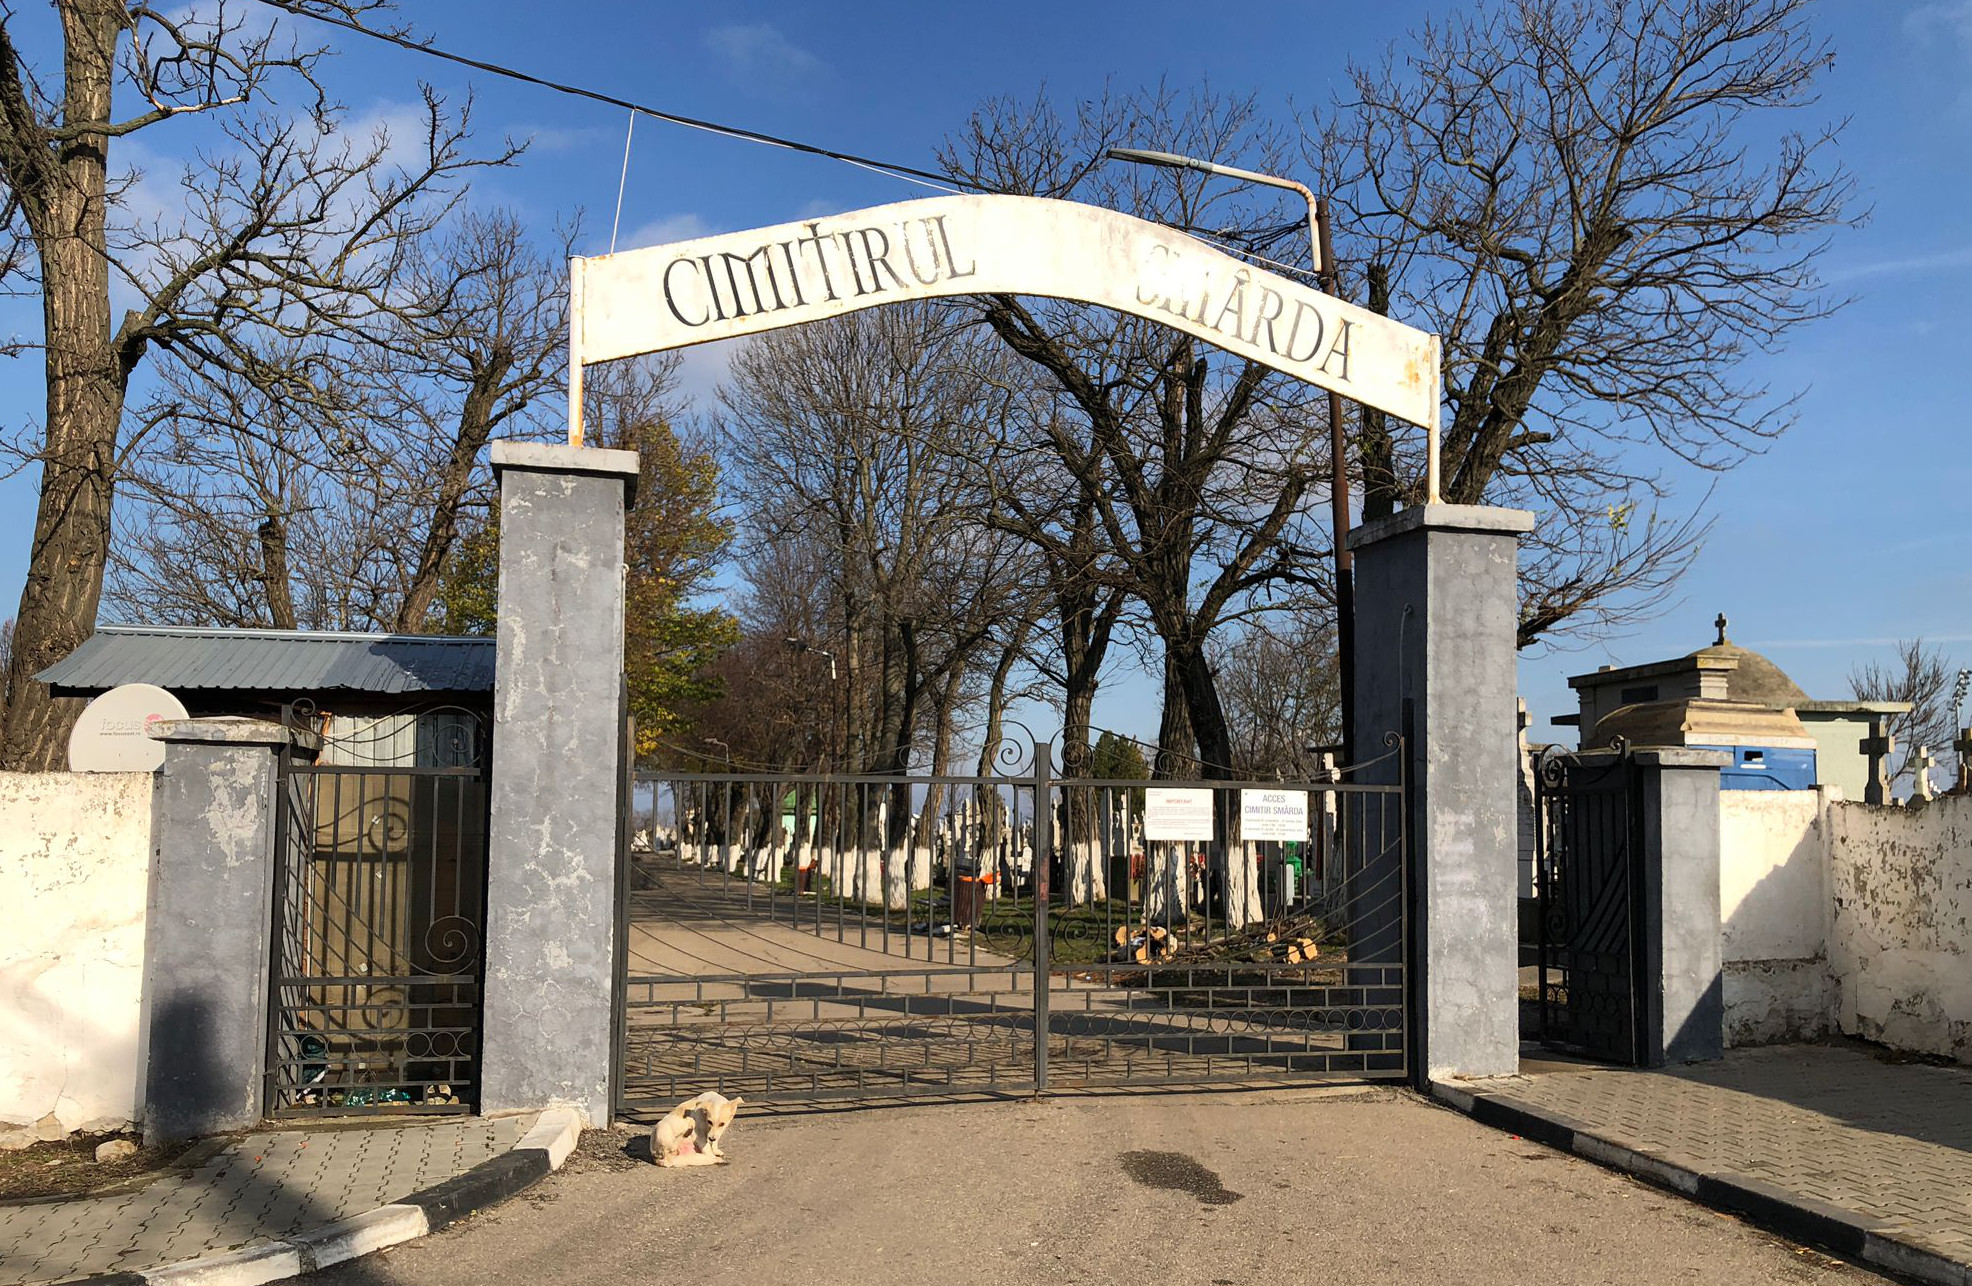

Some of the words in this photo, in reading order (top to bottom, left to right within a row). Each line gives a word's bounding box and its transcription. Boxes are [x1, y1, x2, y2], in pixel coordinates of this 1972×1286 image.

[663, 214, 976, 327] CIMITIRUL
[99, 718, 141, 731] focus
[1262, 794, 1286, 803] ACCES
[1244, 805, 1271, 814] CIMITIR
